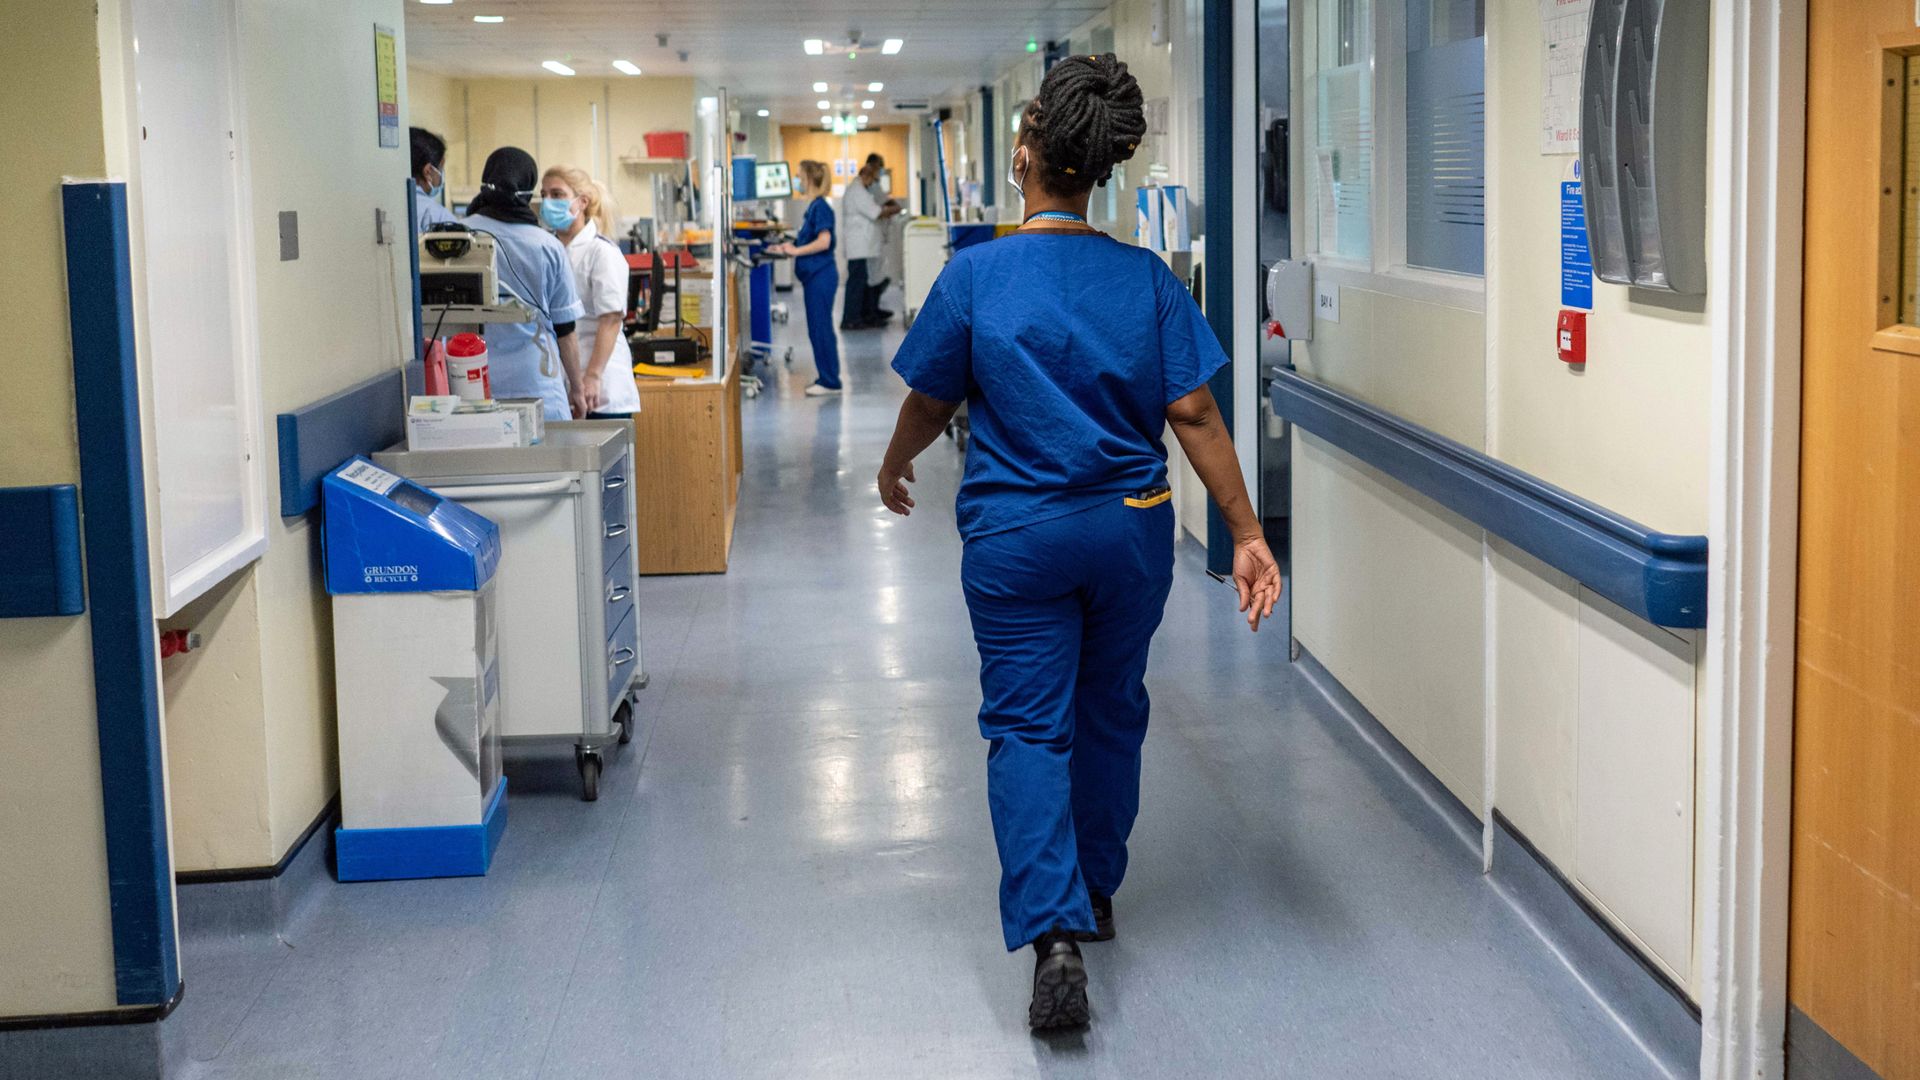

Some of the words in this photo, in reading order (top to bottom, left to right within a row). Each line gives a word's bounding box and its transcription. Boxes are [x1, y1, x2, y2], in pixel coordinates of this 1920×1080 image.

[1566, 184, 1575, 195] Fire
[364, 565, 418, 574] GRUNDON
[374, 575, 408, 583] RECYCLE
